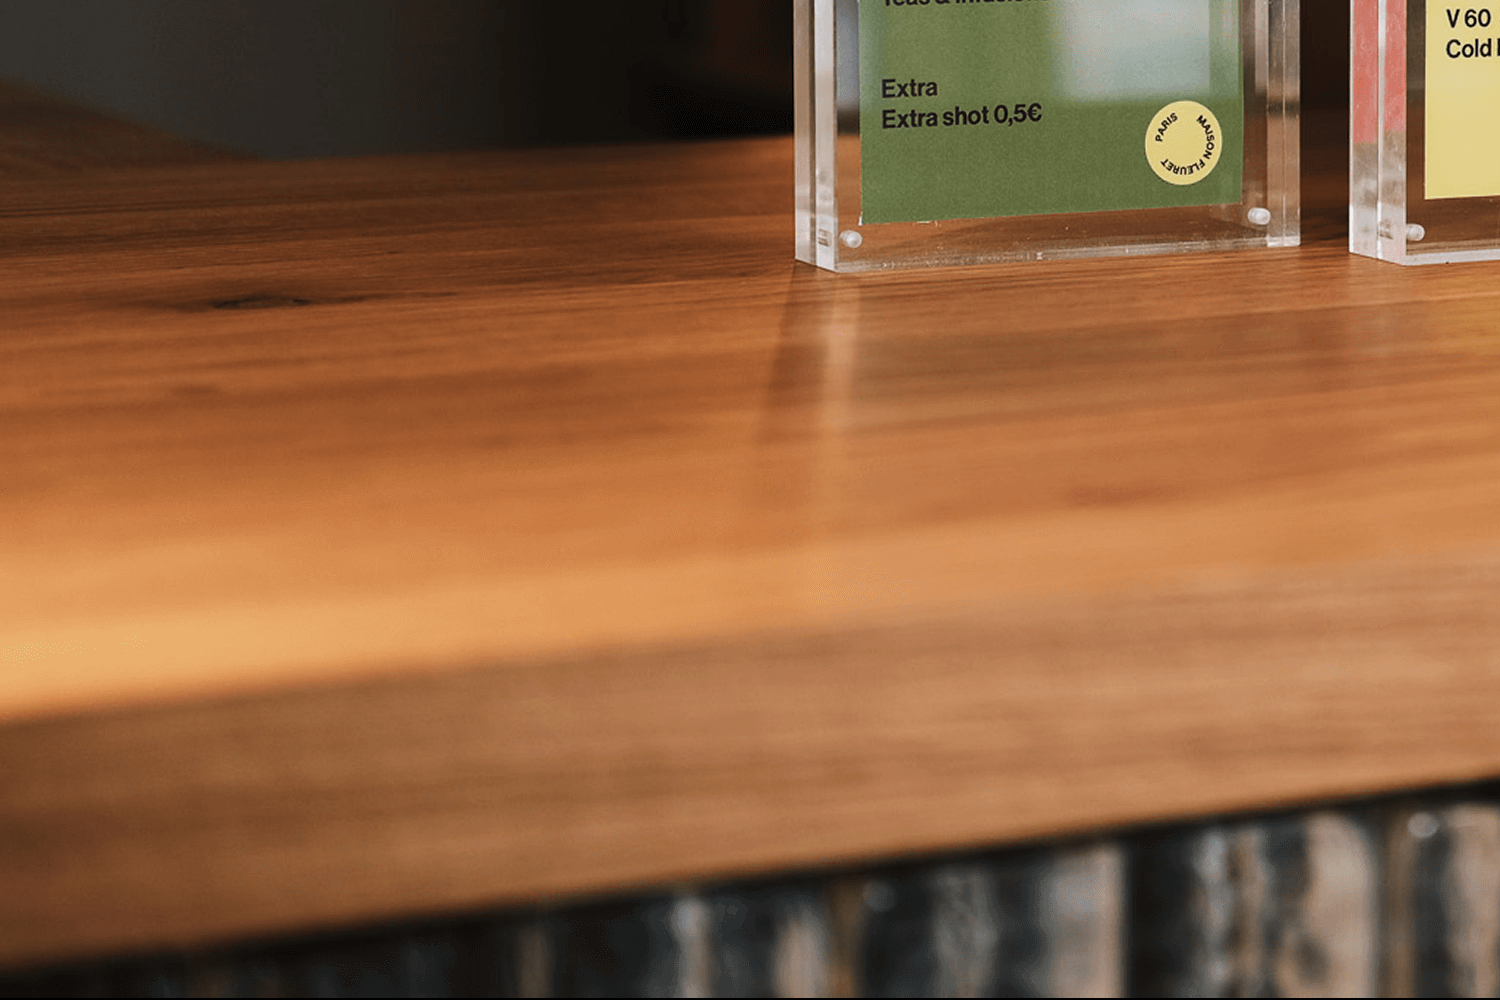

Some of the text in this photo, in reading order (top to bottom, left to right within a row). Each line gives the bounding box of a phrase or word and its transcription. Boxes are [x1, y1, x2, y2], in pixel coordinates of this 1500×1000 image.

[1446, 38, 1492, 58] Cold
[881, 78, 938, 98] Extra
[881, 103, 1042, 129] Extra shot 0,5€
[1155, 112, 1178, 142] PARIS
[1160, 115, 1215, 175] MAISON FLEURET
